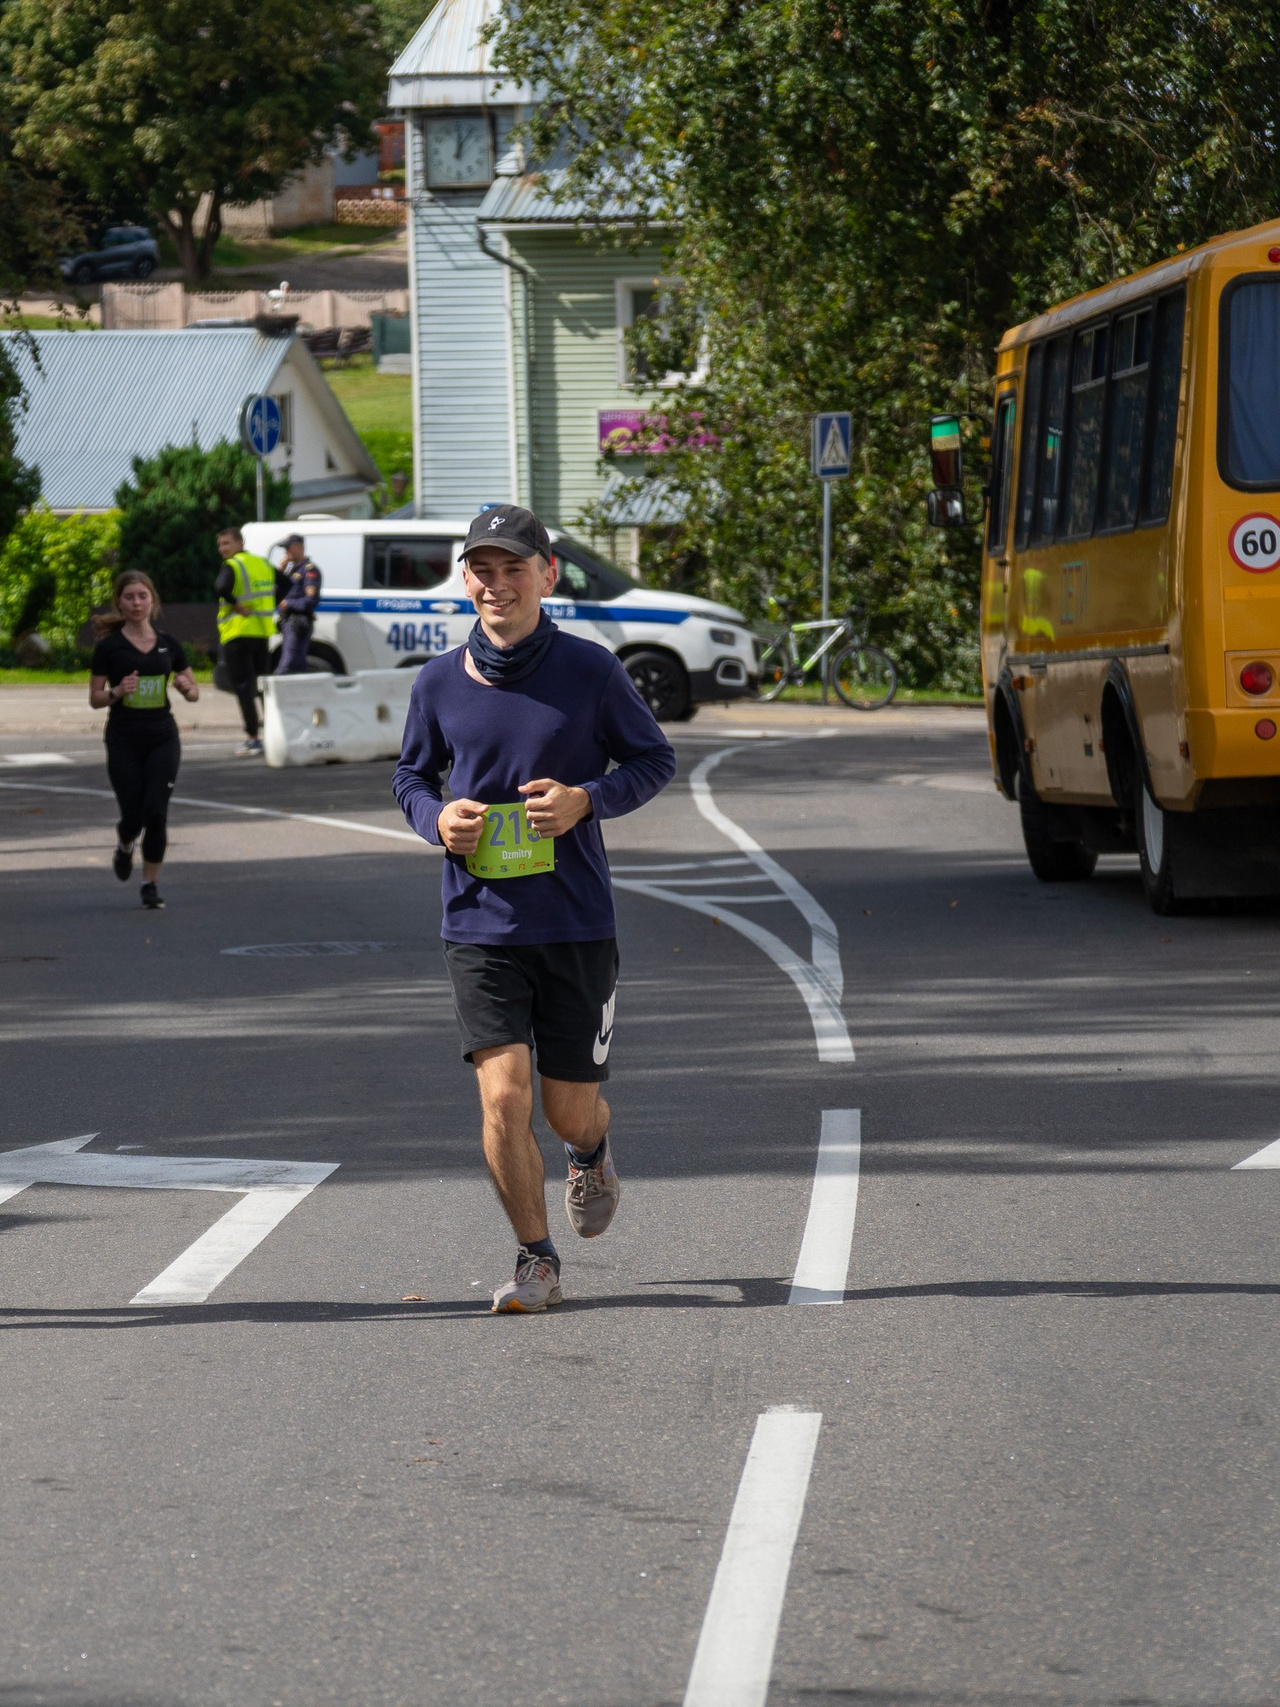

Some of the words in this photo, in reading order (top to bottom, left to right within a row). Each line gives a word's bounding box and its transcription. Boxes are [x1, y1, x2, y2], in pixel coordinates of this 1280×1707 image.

[1241, 529, 1276, 556] 60
[387, 622, 448, 651] 4045
[140, 680, 161, 697] 591
[502, 849, 532, 861] Dzmitry
